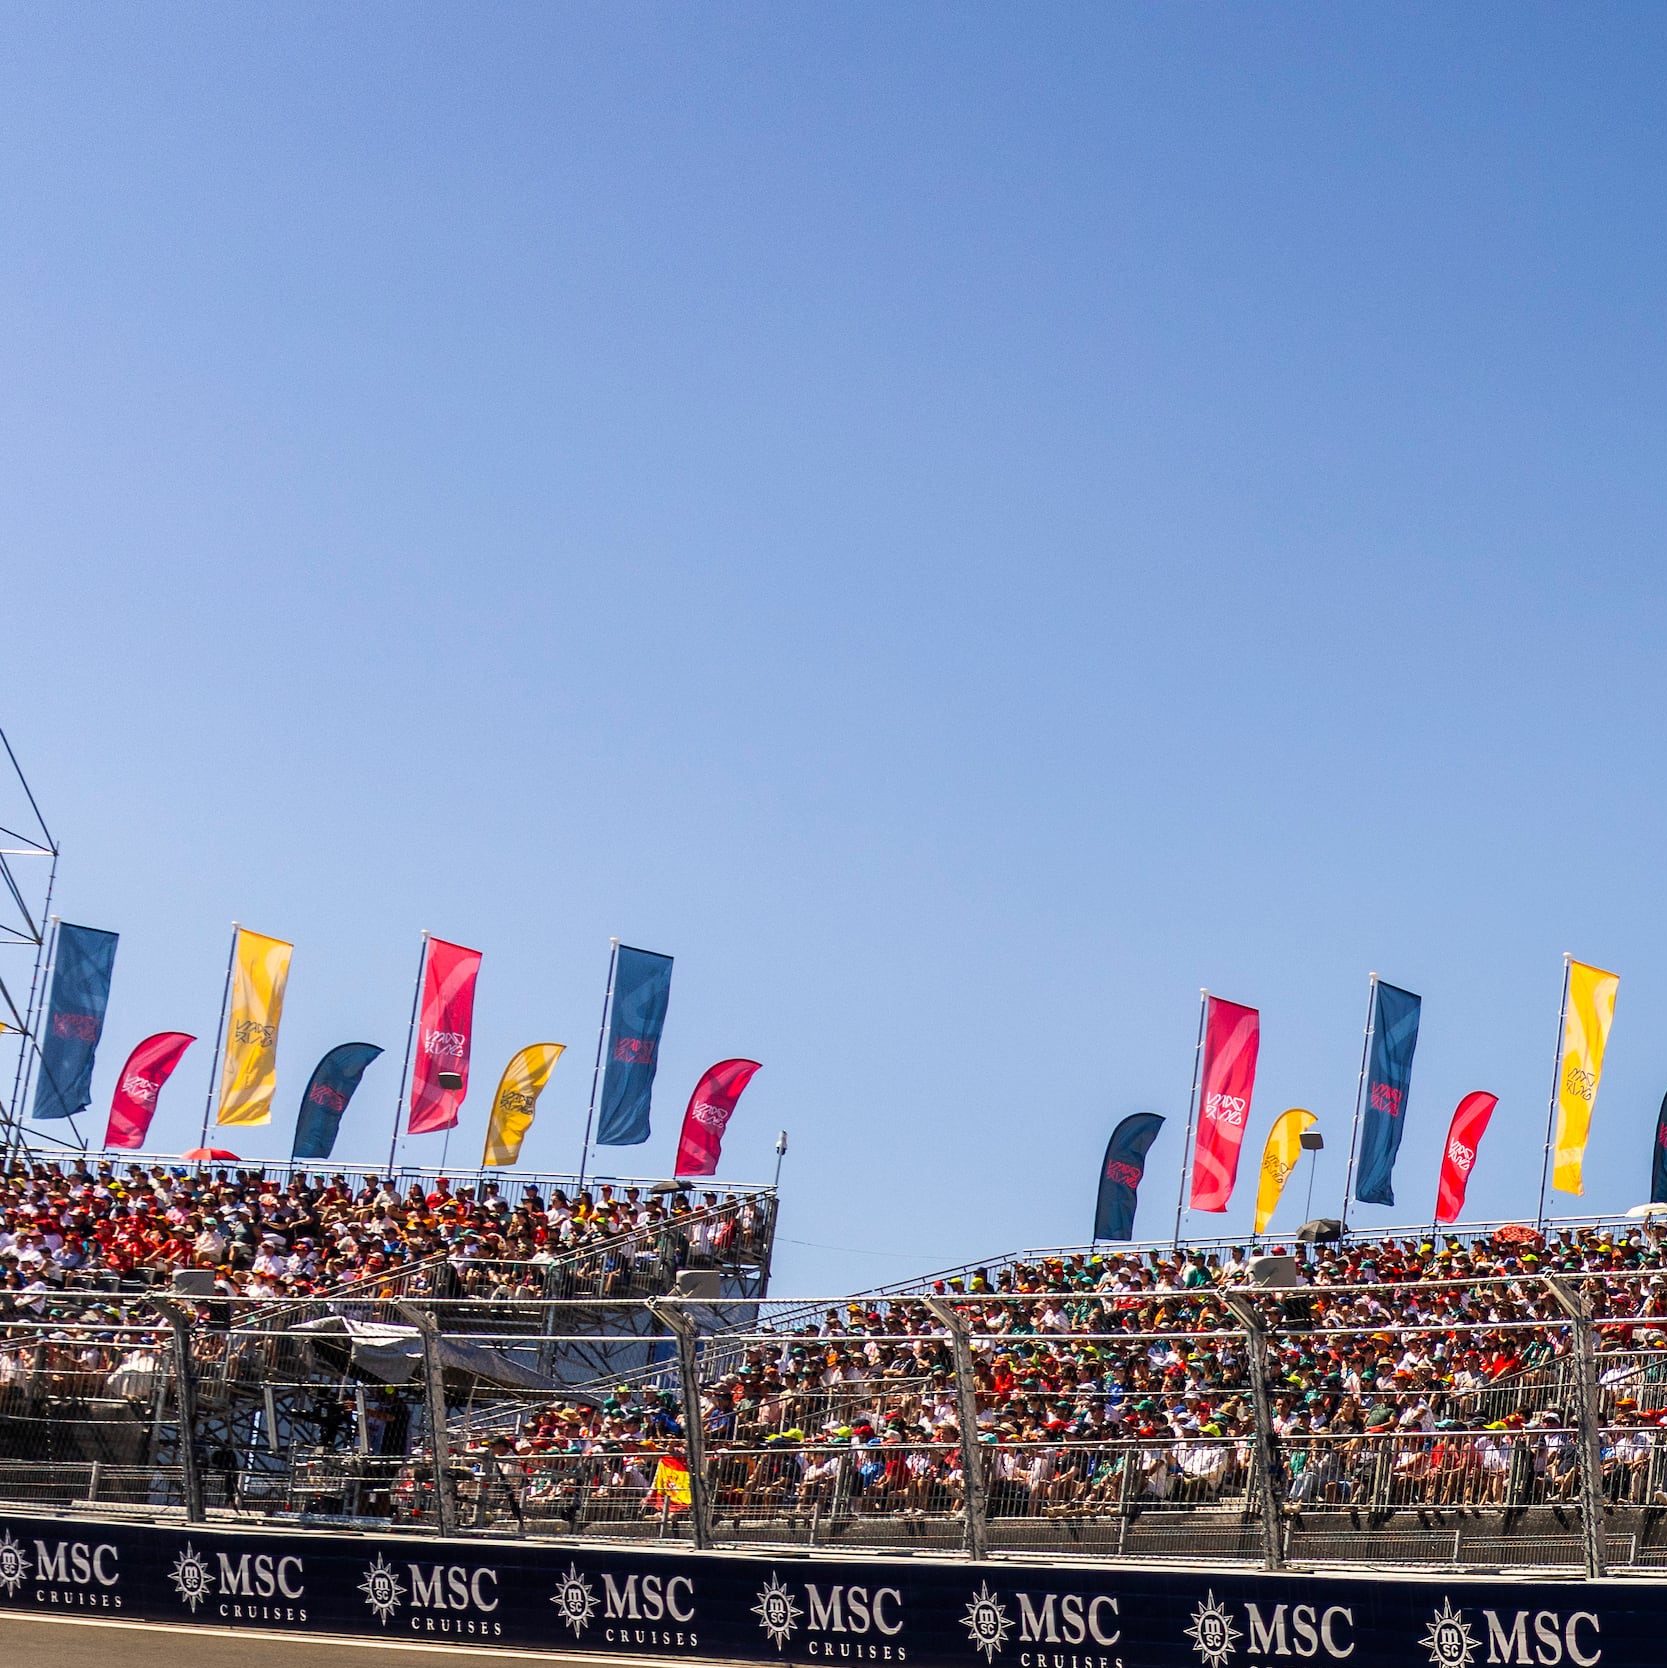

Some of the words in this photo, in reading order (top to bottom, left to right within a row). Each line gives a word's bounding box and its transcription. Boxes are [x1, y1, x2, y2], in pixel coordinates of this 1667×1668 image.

[34, 1541, 119, 1586] MSC
[217, 1553, 304, 1598] MSC
[37, 1590, 122, 1607] CRUISES
[408, 1565, 499, 1611] MSC
[602, 1574, 695, 1622] MSC
[805, 1584, 903, 1635] MSC
[220, 1604, 307, 1621] CRUISES
[412, 1617, 502, 1635] CRUISES
[1016, 1593, 1121, 1646] MSC
[1244, 1603, 1355, 1658] MSC
[606, 1629, 698, 1646] CRUISES
[809, 1642, 906, 1660] CRUISES
[1483, 1611, 1602, 1666] MSC
